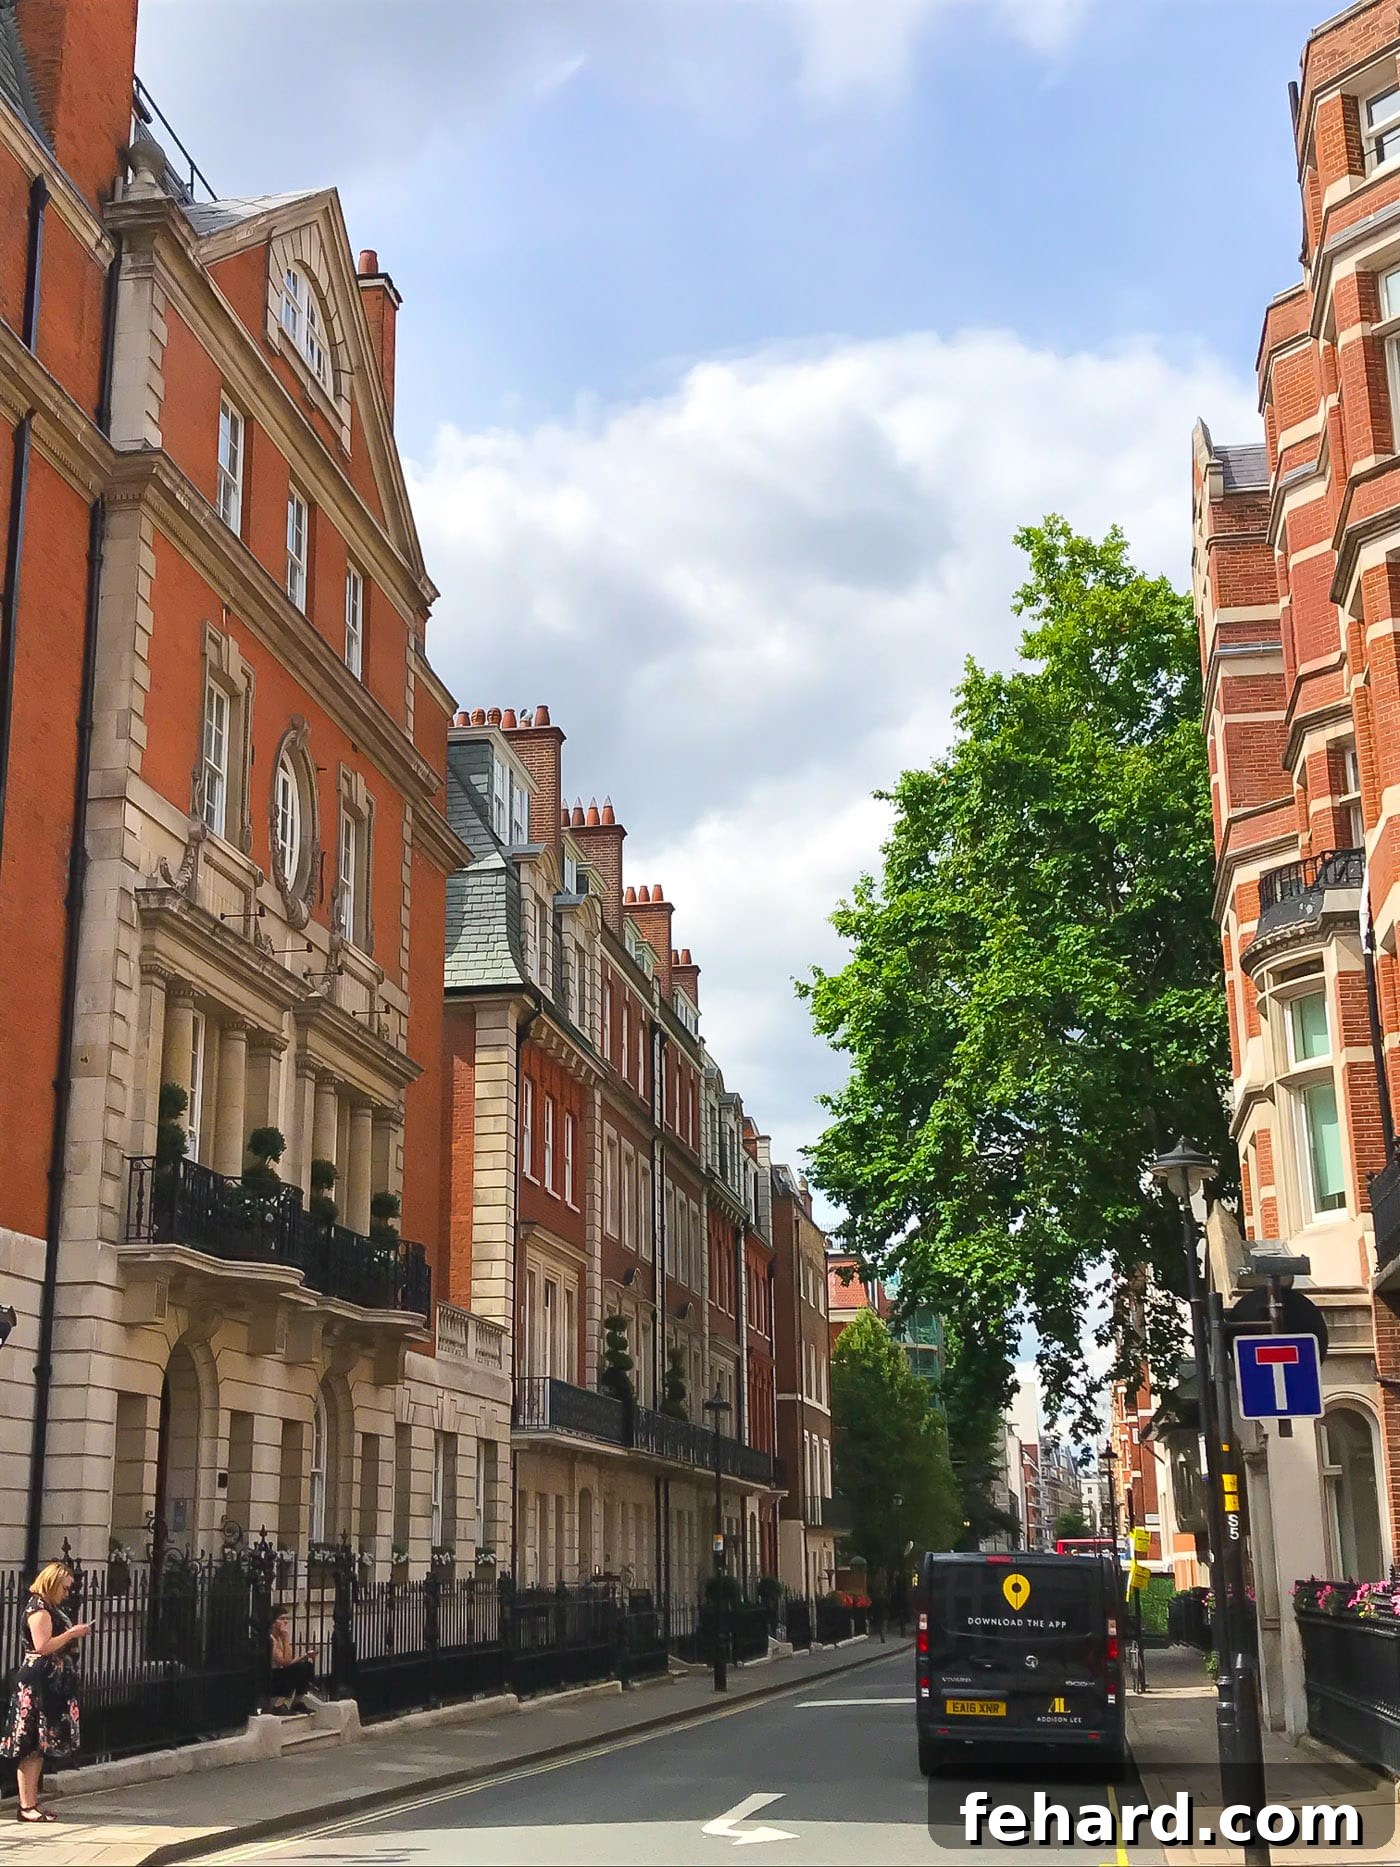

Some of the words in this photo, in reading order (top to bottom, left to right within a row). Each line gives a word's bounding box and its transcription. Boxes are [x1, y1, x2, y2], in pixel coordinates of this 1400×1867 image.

[967, 1617, 1023, 1626] DOWNLOAD
[1027, 1619, 1044, 1628] THE
[952, 1702, 976, 1713] EA16
